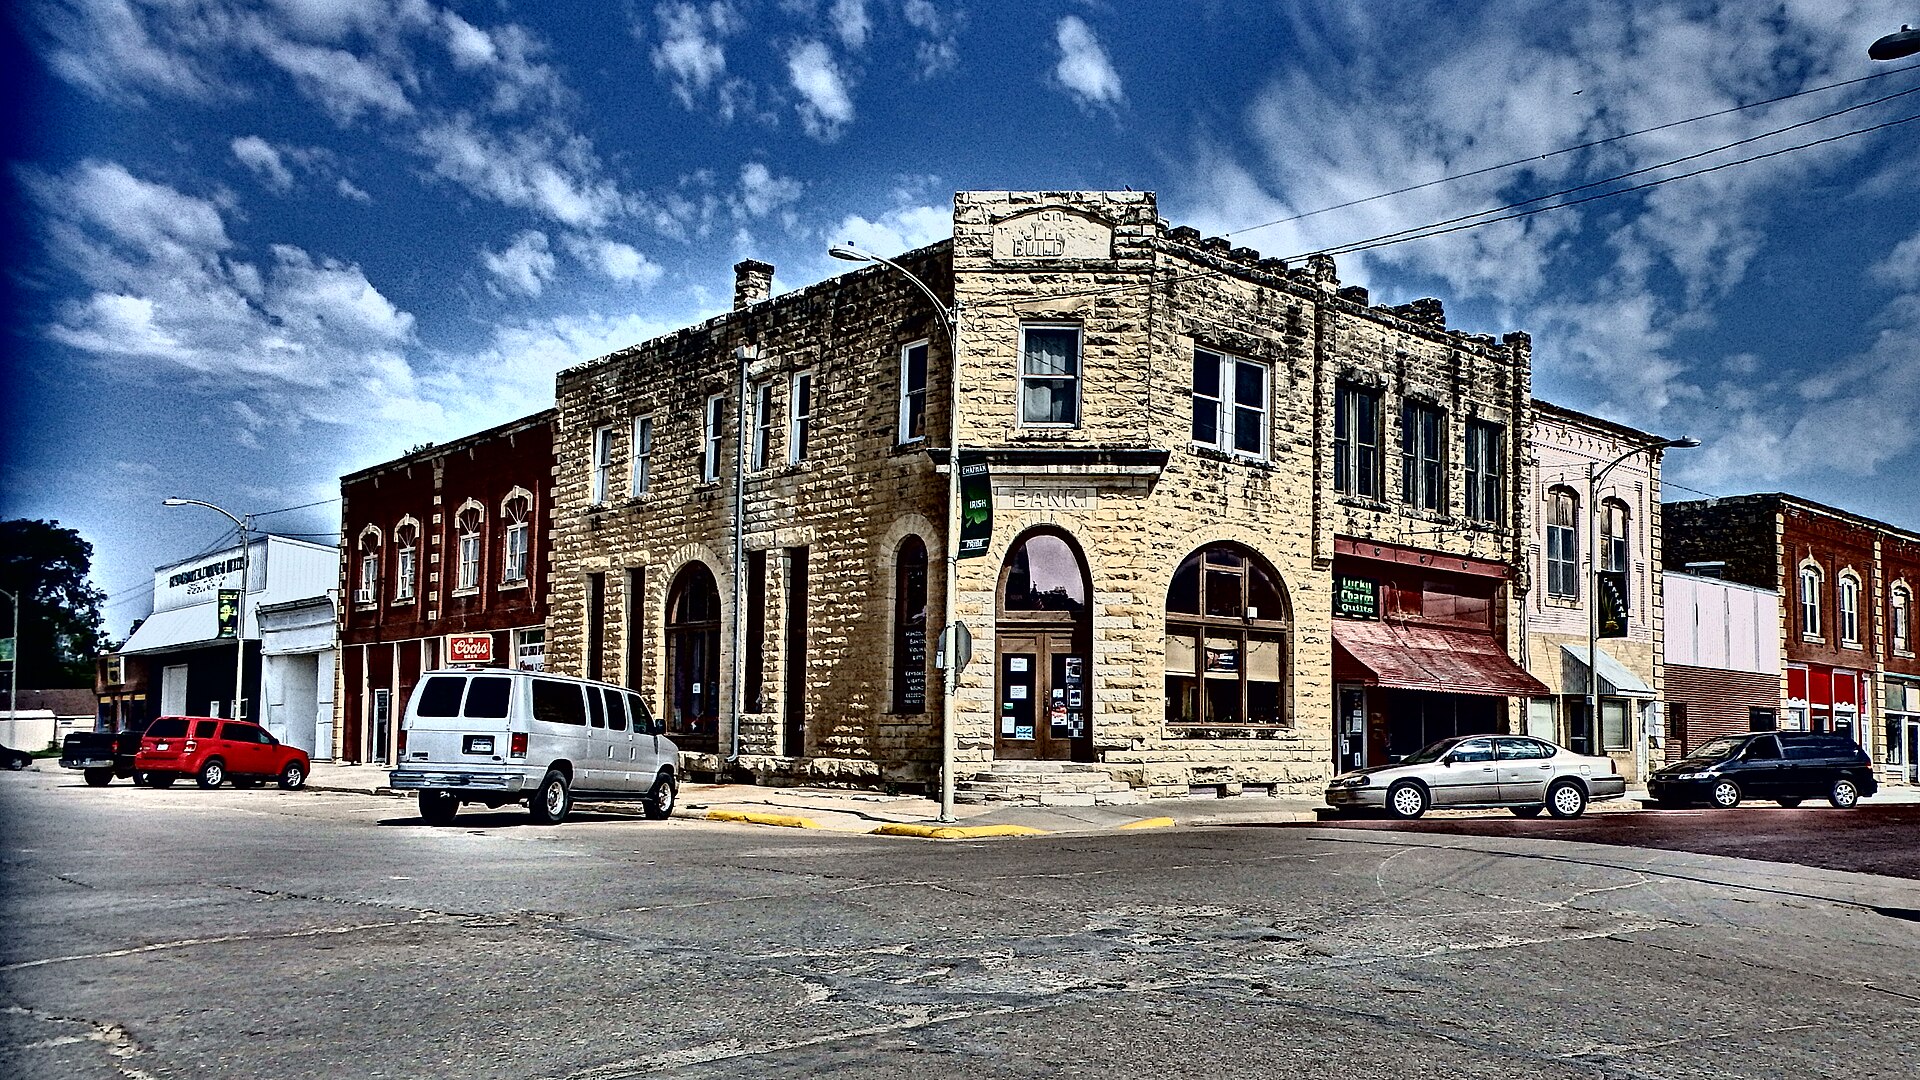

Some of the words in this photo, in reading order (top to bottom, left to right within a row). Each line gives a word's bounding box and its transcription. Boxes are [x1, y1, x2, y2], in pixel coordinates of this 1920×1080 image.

[970, 500, 987, 509] IRISH
[1342, 577, 1372, 595] Lucky
[1341, 589, 1374, 606] Charm
[1341, 603, 1374, 614] Quilts
[454, 640, 488, 655] Coors
